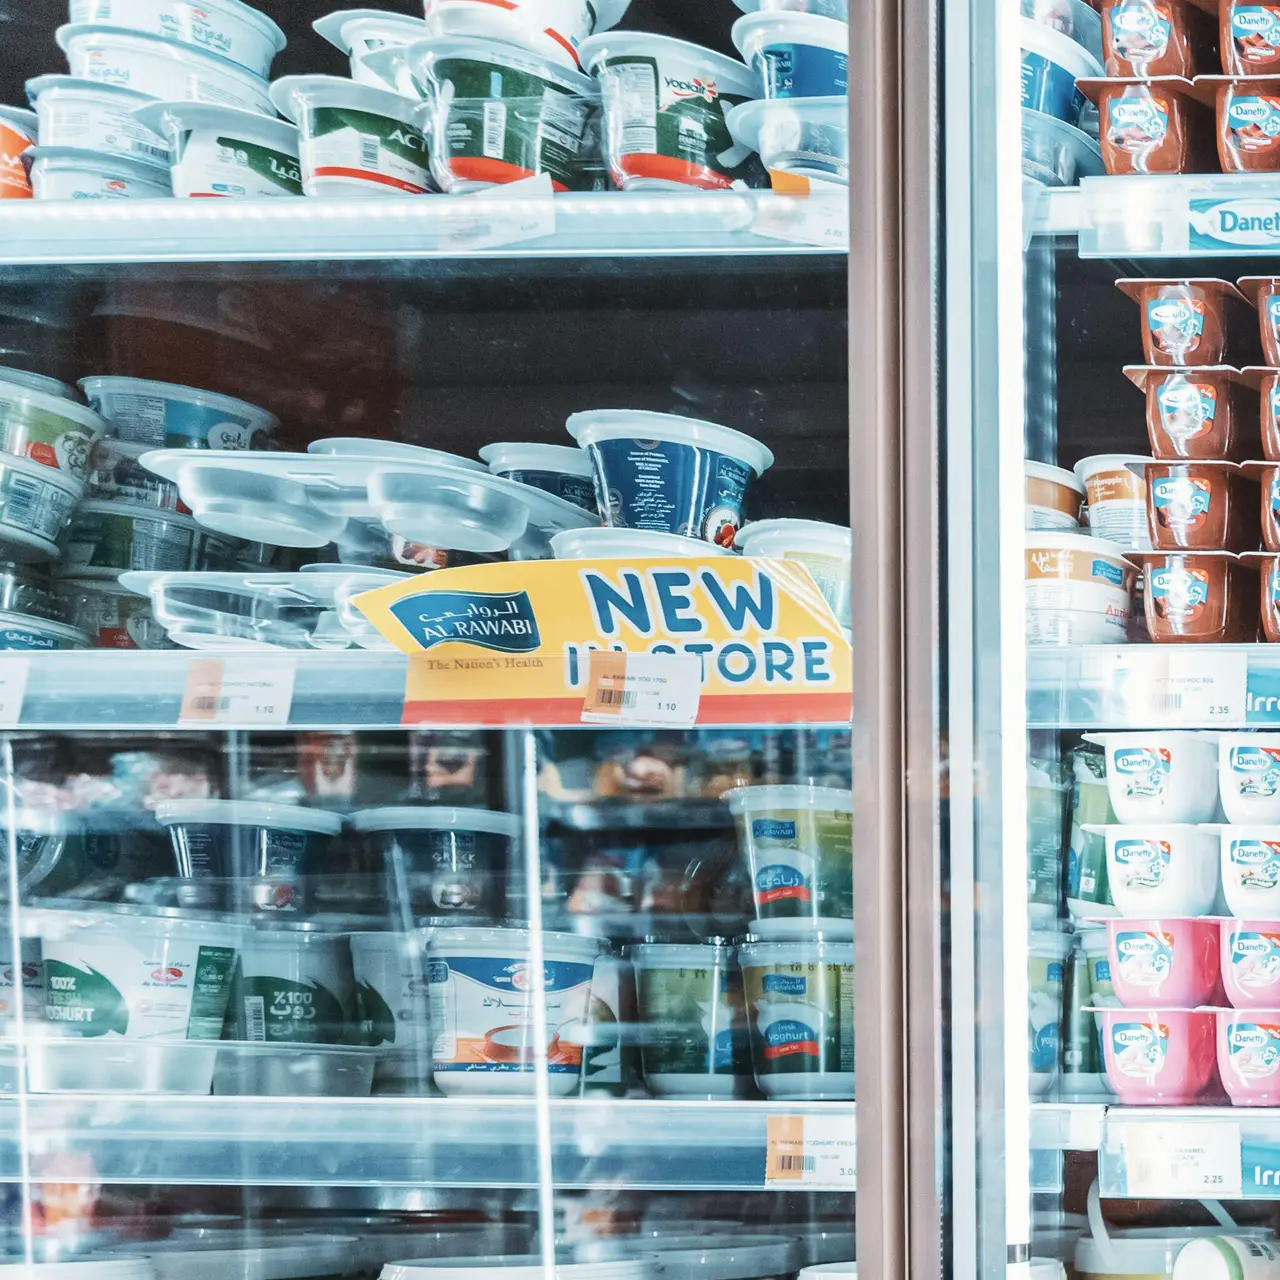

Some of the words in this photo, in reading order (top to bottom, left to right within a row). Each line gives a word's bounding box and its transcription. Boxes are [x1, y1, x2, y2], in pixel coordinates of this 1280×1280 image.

[585, 572, 775, 634] NEW
[419, 601, 519, 624] الروابي
[423, 625, 454, 641] AL
[456, 619, 532, 638] RAWABI
[428, 659, 450, 670] The
[452, 658, 501, 670] Nation's
[504, 658, 543, 669] Health
[653, 641, 830, 682] TORE
[657, 702, 677, 712] 1.10
[1209, 706, 1230, 715] 2.35
[1203, 1175, 1223, 1184] 2.25
